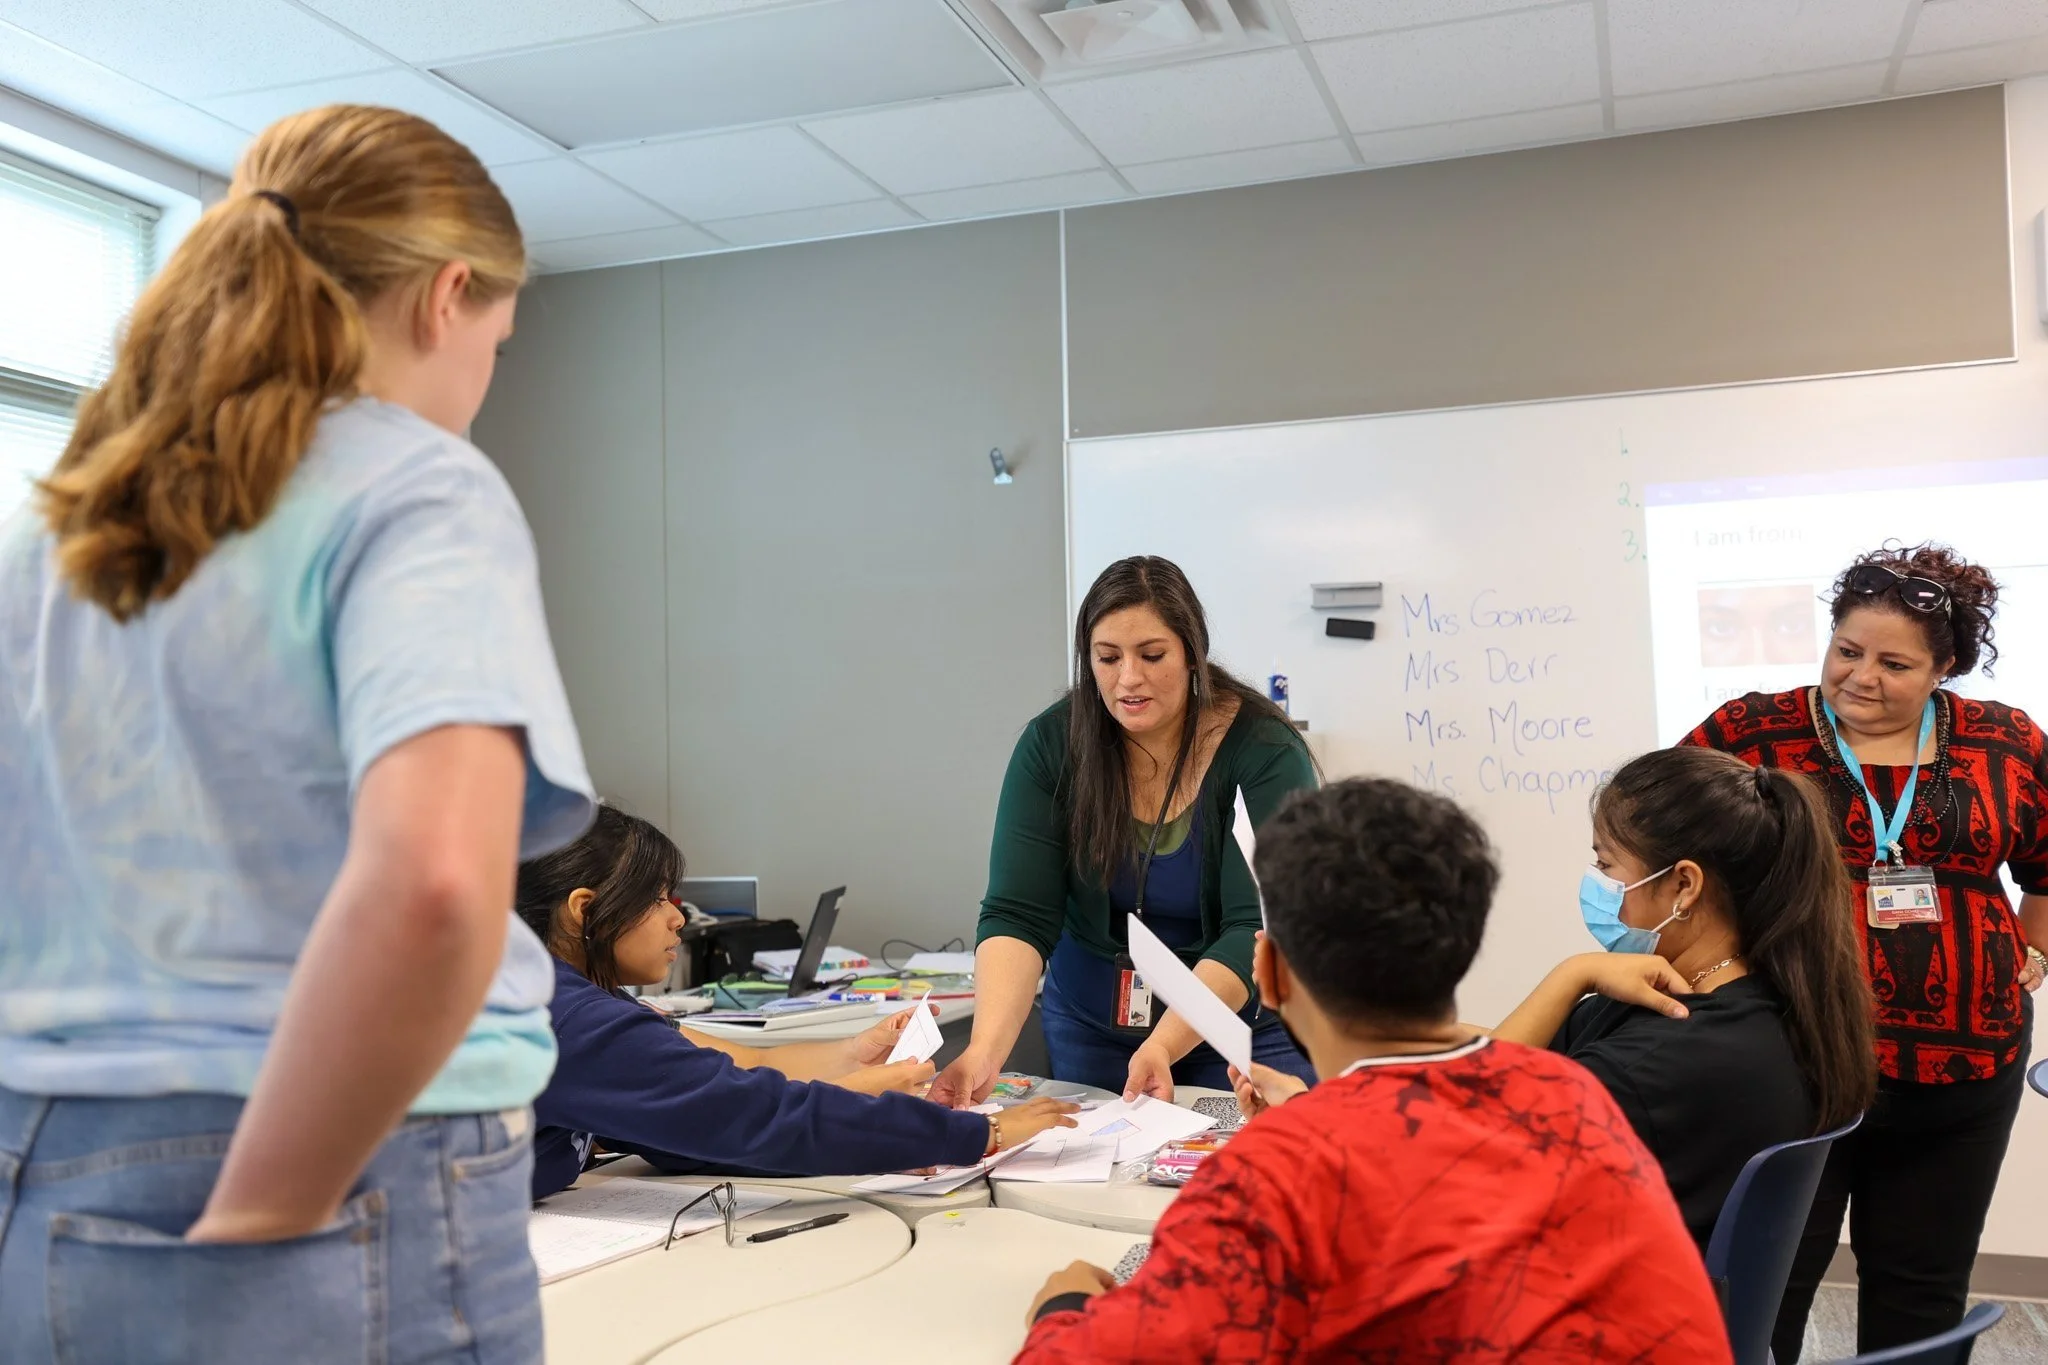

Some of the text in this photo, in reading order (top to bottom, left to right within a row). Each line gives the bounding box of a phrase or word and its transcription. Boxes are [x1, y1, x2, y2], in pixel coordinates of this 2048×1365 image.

[1617, 480, 1640, 508] 2.
[1621, 528, 1647, 563] 3.
[1707, 531, 1742, 546] am
[1470, 588, 1578, 628] Gomez
[1486, 647, 1558, 683] Derr
[1406, 700, 1594, 756] Mrs. Moore
[1413, 760, 1463, 798] Ms.
